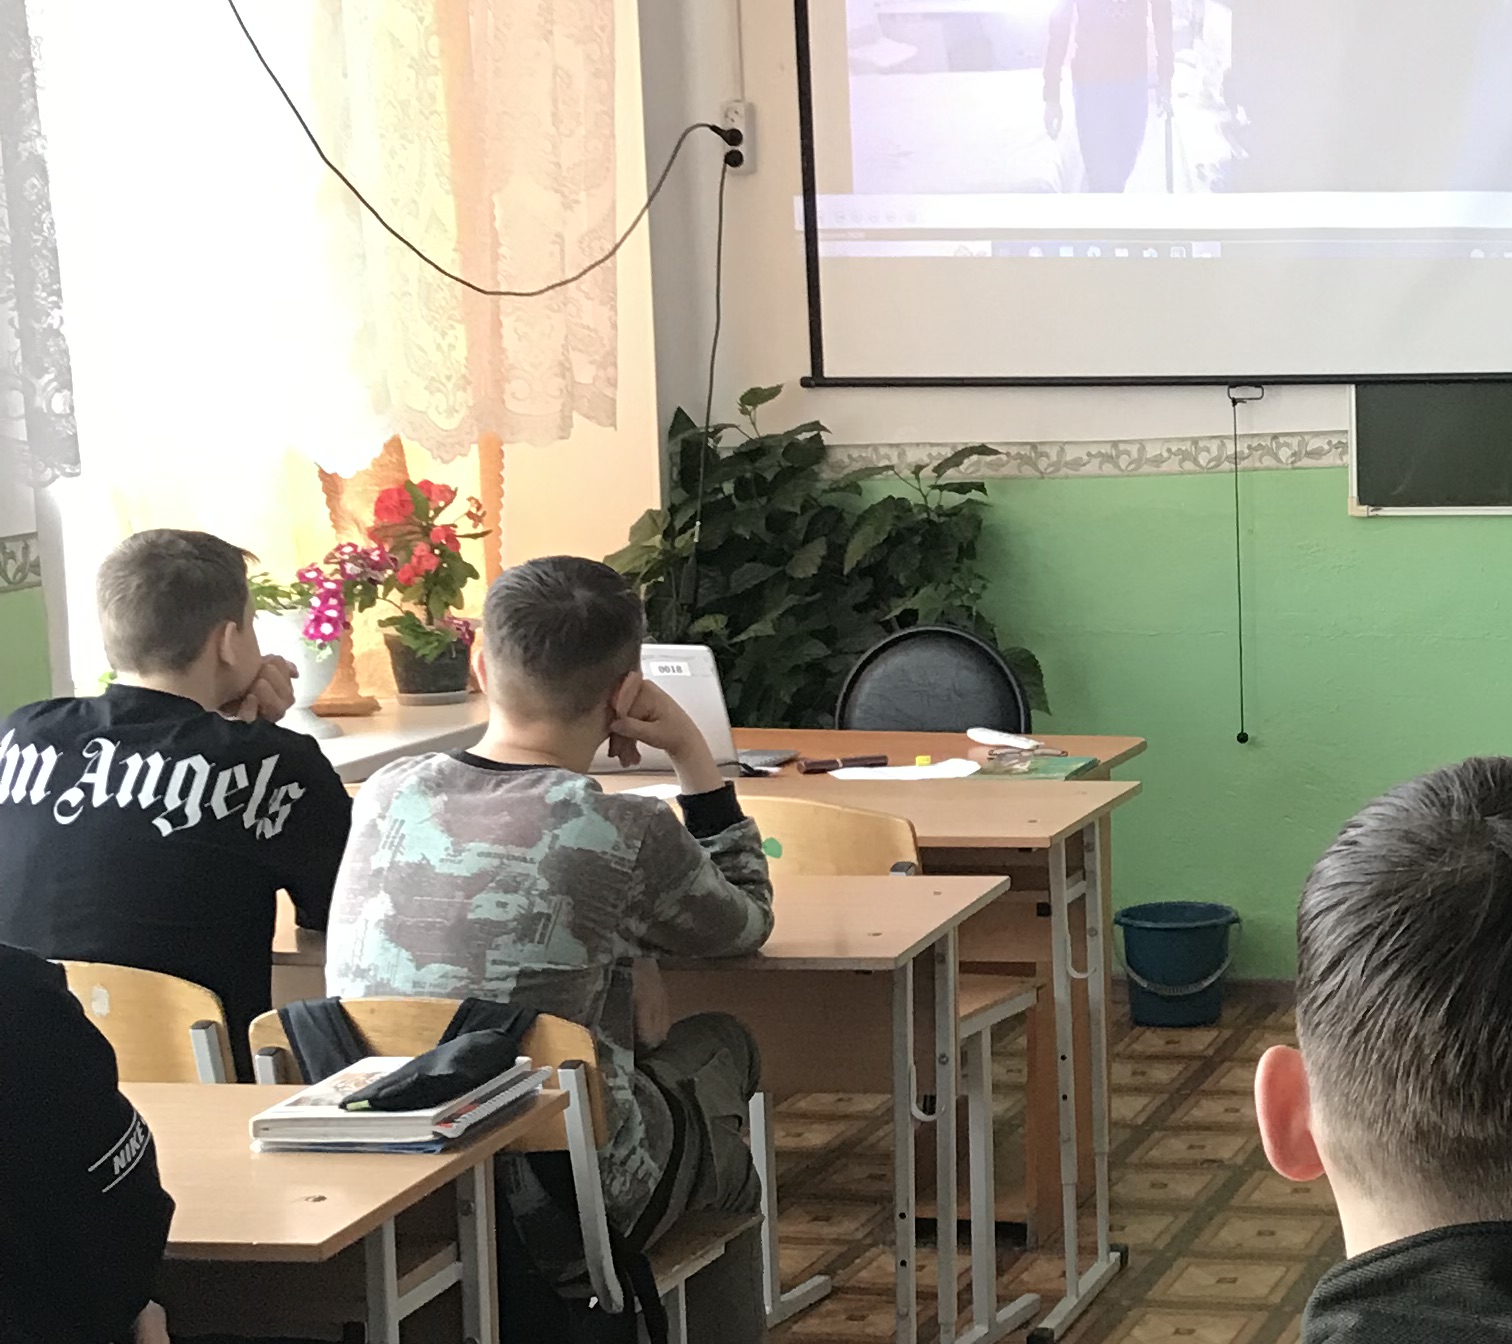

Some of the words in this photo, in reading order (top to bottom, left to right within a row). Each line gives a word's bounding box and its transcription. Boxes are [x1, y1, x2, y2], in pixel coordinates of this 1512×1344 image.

[658, 665, 683, 673] 0018
[53, 737, 307, 839] Angels
[113, 1121, 145, 1175] NIKE
